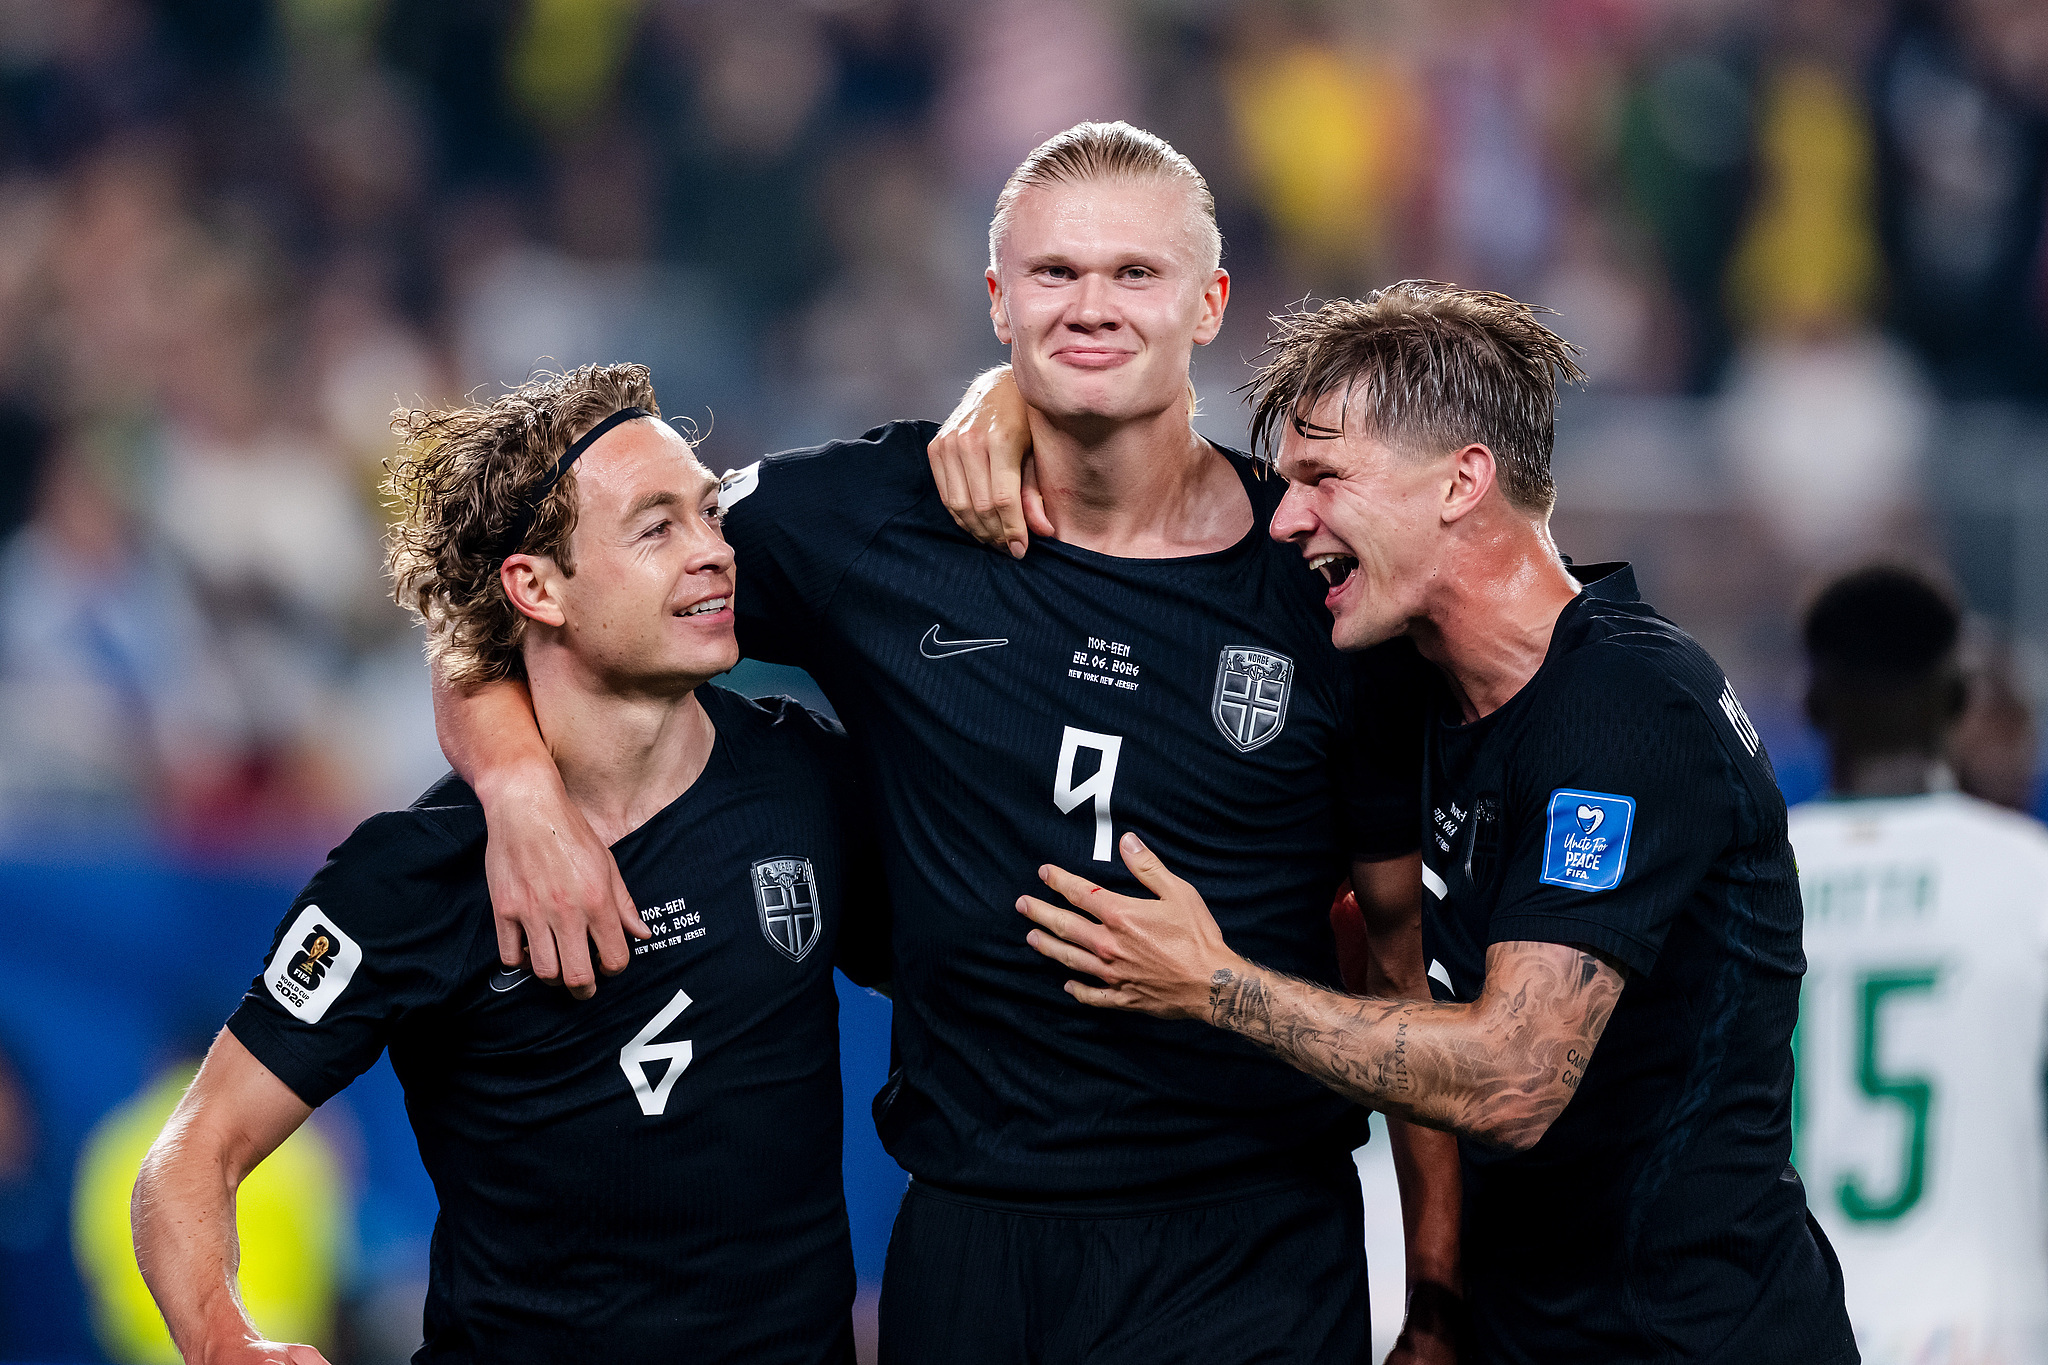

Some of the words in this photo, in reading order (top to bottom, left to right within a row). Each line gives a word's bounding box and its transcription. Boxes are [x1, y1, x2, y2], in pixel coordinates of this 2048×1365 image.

[1087, 636, 1131, 658] NOR-SEN
[1247, 653, 1270, 666] NORGE
[1067, 668, 1082, 679] NEW
[1083, 671, 1100, 683] YORK
[1100, 675, 1115, 686] NEW
[1114, 679, 1139, 691] JERSEY
[1053, 725, 1123, 862] 9
[1564, 833, 1593, 852] Unite
[1591, 837, 1608, 853] For
[1564, 851, 1602, 871] PEACE
[1565, 868, 1589, 880] FIFA
[641, 897, 686, 922] NOR-SEN
[634, 945, 649, 955] NEW
[649, 939, 668, 951] YORK
[667, 935, 682, 946] NEW
[683, 927, 706, 941] JERSEY
[280, 974, 300, 992] WORLD
[298, 989, 310, 1001] CUP
[293, 968, 311, 985] FIFA
[275, 980, 305, 1008] 2026
[619, 988, 694, 1116] 6
